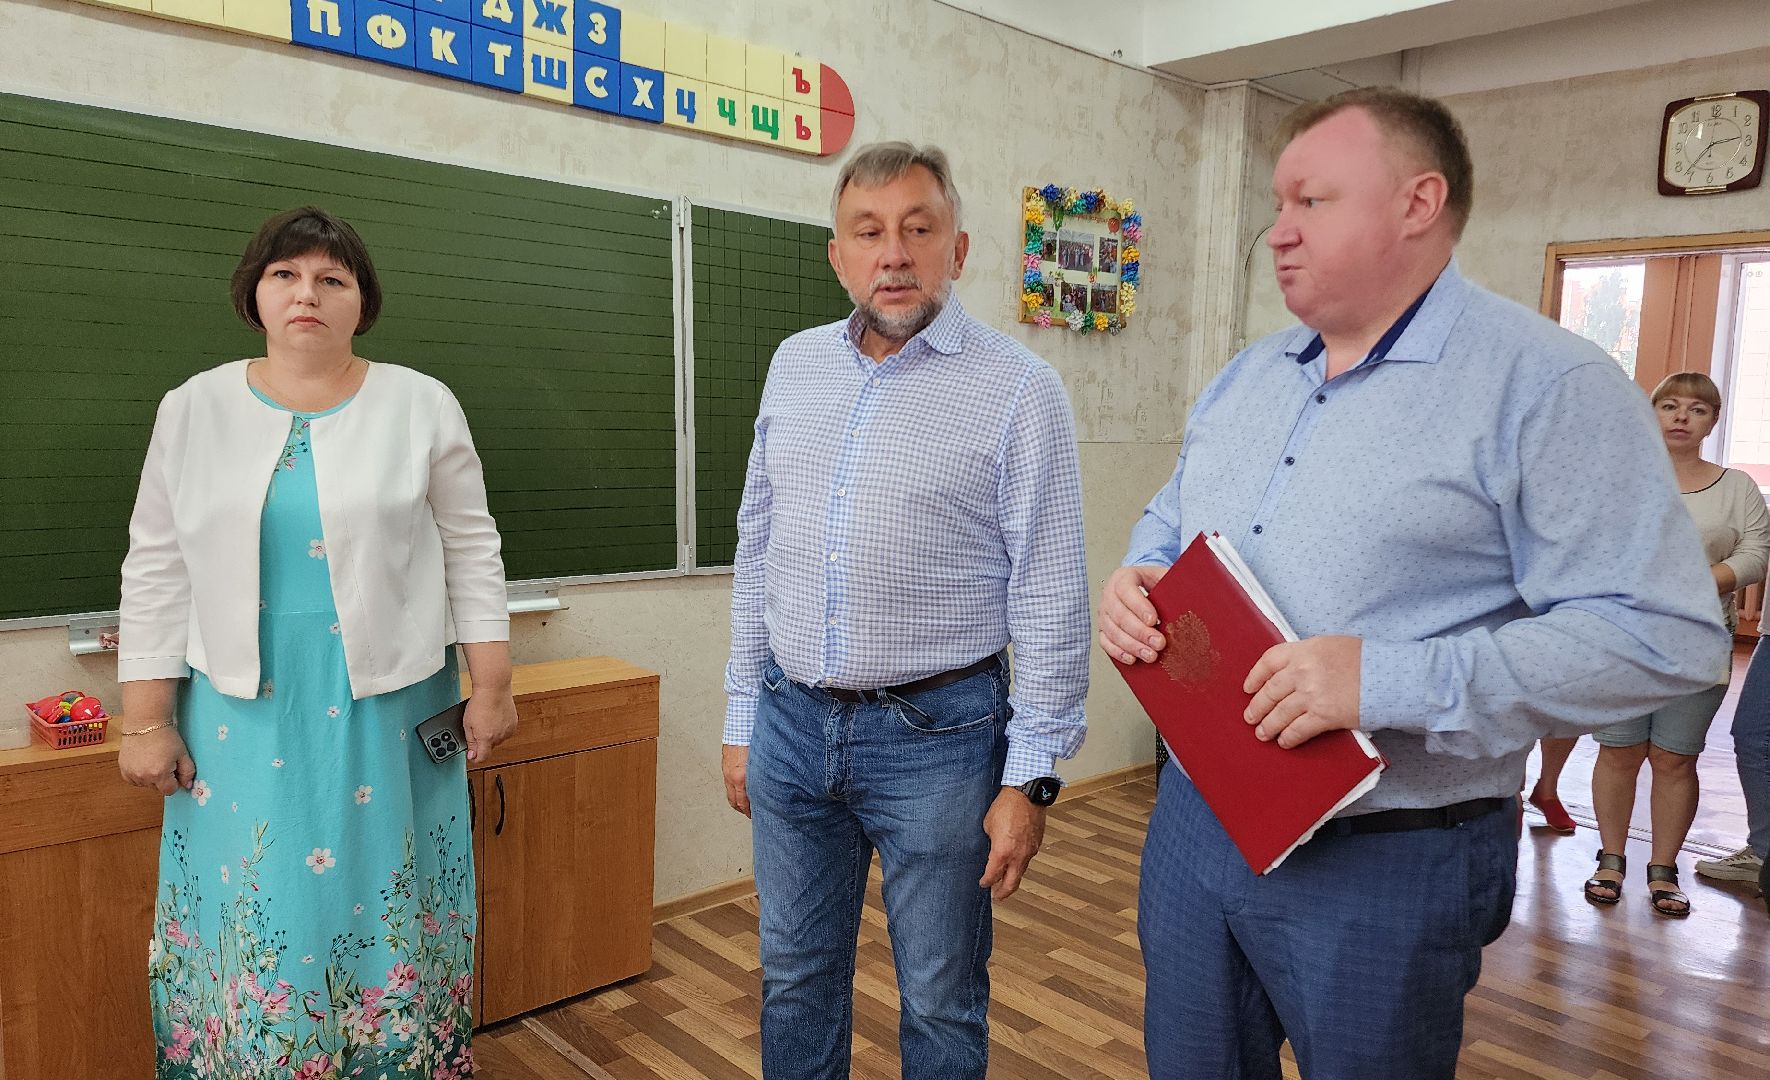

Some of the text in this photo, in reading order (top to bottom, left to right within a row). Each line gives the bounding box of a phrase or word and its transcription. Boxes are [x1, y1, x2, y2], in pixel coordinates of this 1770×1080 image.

[532, 0, 568, 36] Ж
[792, 67, 811, 95] Ъ
[307, 0, 812, 141] П Ф К Т Ш С Х Ц Ч Щ Ь
[1691, 111, 1700, 123] 11
[1711, 104, 1722, 118] 12
[1744, 114, 1752, 127] 2
[1678, 122, 1688, 135] 10
[1744, 134, 1753, 147] 3
[1674, 142, 1683, 156] 9
[1674, 161, 1683, 173] 8
[1739, 154, 1748, 167] 4
[1686, 169, 1695, 183] 7
[1706, 172, 1714, 184] 6
[1726, 166, 1734, 179] 5
